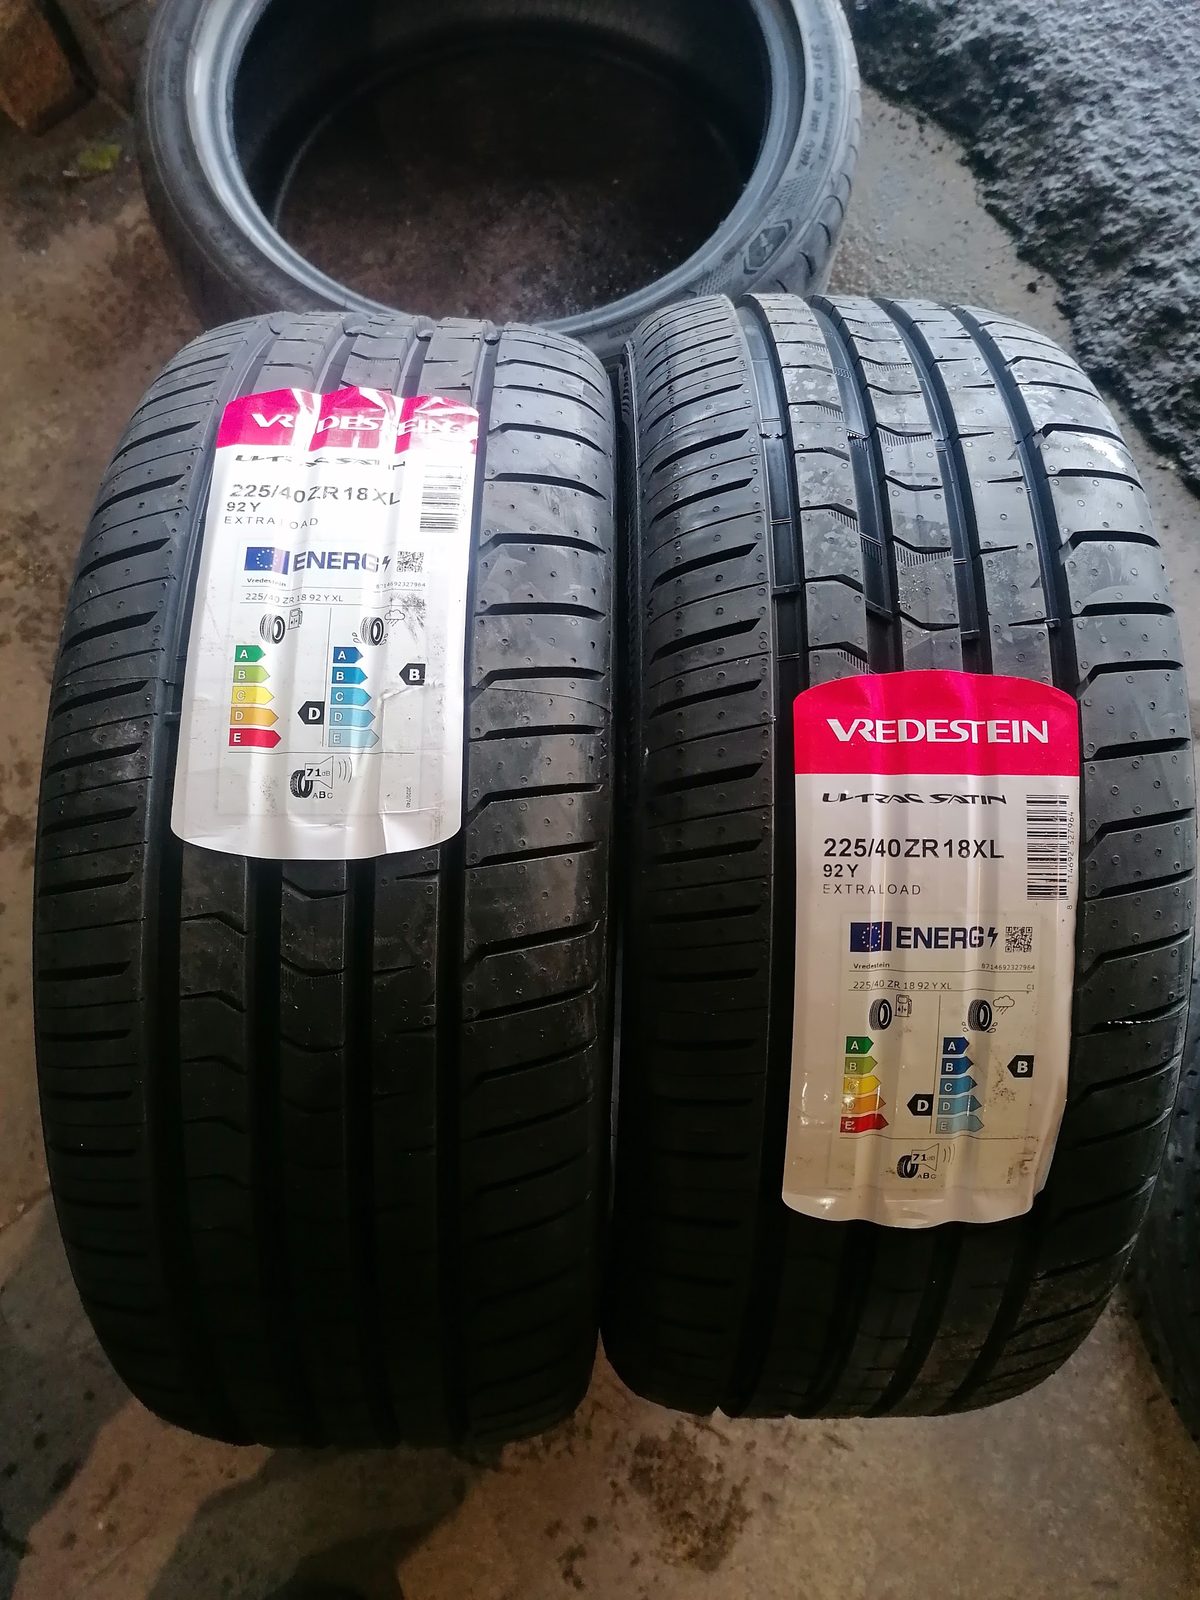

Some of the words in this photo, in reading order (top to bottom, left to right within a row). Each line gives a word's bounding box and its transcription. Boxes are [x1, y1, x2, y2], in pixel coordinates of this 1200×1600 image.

[251, 413, 447, 437] VRDESEIN
[224, 515, 319, 530] EXTRAOAD
[247, 577, 287, 587] Vredesin
[240, 649, 249, 659] A
[338, 651, 346, 660] A
[238, 670, 246, 680] B
[336, 671, 344, 681] B
[409, 669, 420, 681] B
[236, 690, 246, 700] C
[335, 692, 344, 701] C
[235, 711, 244, 721] D
[308, 707, 321, 720] D
[334, 713, 343, 722] D
[826, 718, 1049, 744] VREDESTEIN
[233, 732, 242, 743] E
[333, 734, 341, 744] E
[822, 792, 924, 804] ULTRAC
[929, 793, 1007, 805] SATIN
[896, 926, 984, 949] ENERG
[853, 961, 890, 970] Vredestein
[853, 979, 885, 990] 225/40
[887, 980, 901, 989] ZR
[903, 981, 915, 990] 18
[917, 981, 930, 990] 92
[940, 982, 952, 990] XL
[850, 1040, 859, 1051] A
[947, 1041, 956, 1051] A
[849, 1062, 857, 1071] B
[945, 1062, 954, 1072] B
[1016, 1060, 1029, 1074] B
[944, 1083, 953, 1092] C
[916, 1099, 929, 1112] D
[942, 1102, 951, 1111] D
[940, 1121, 948, 1130] E
